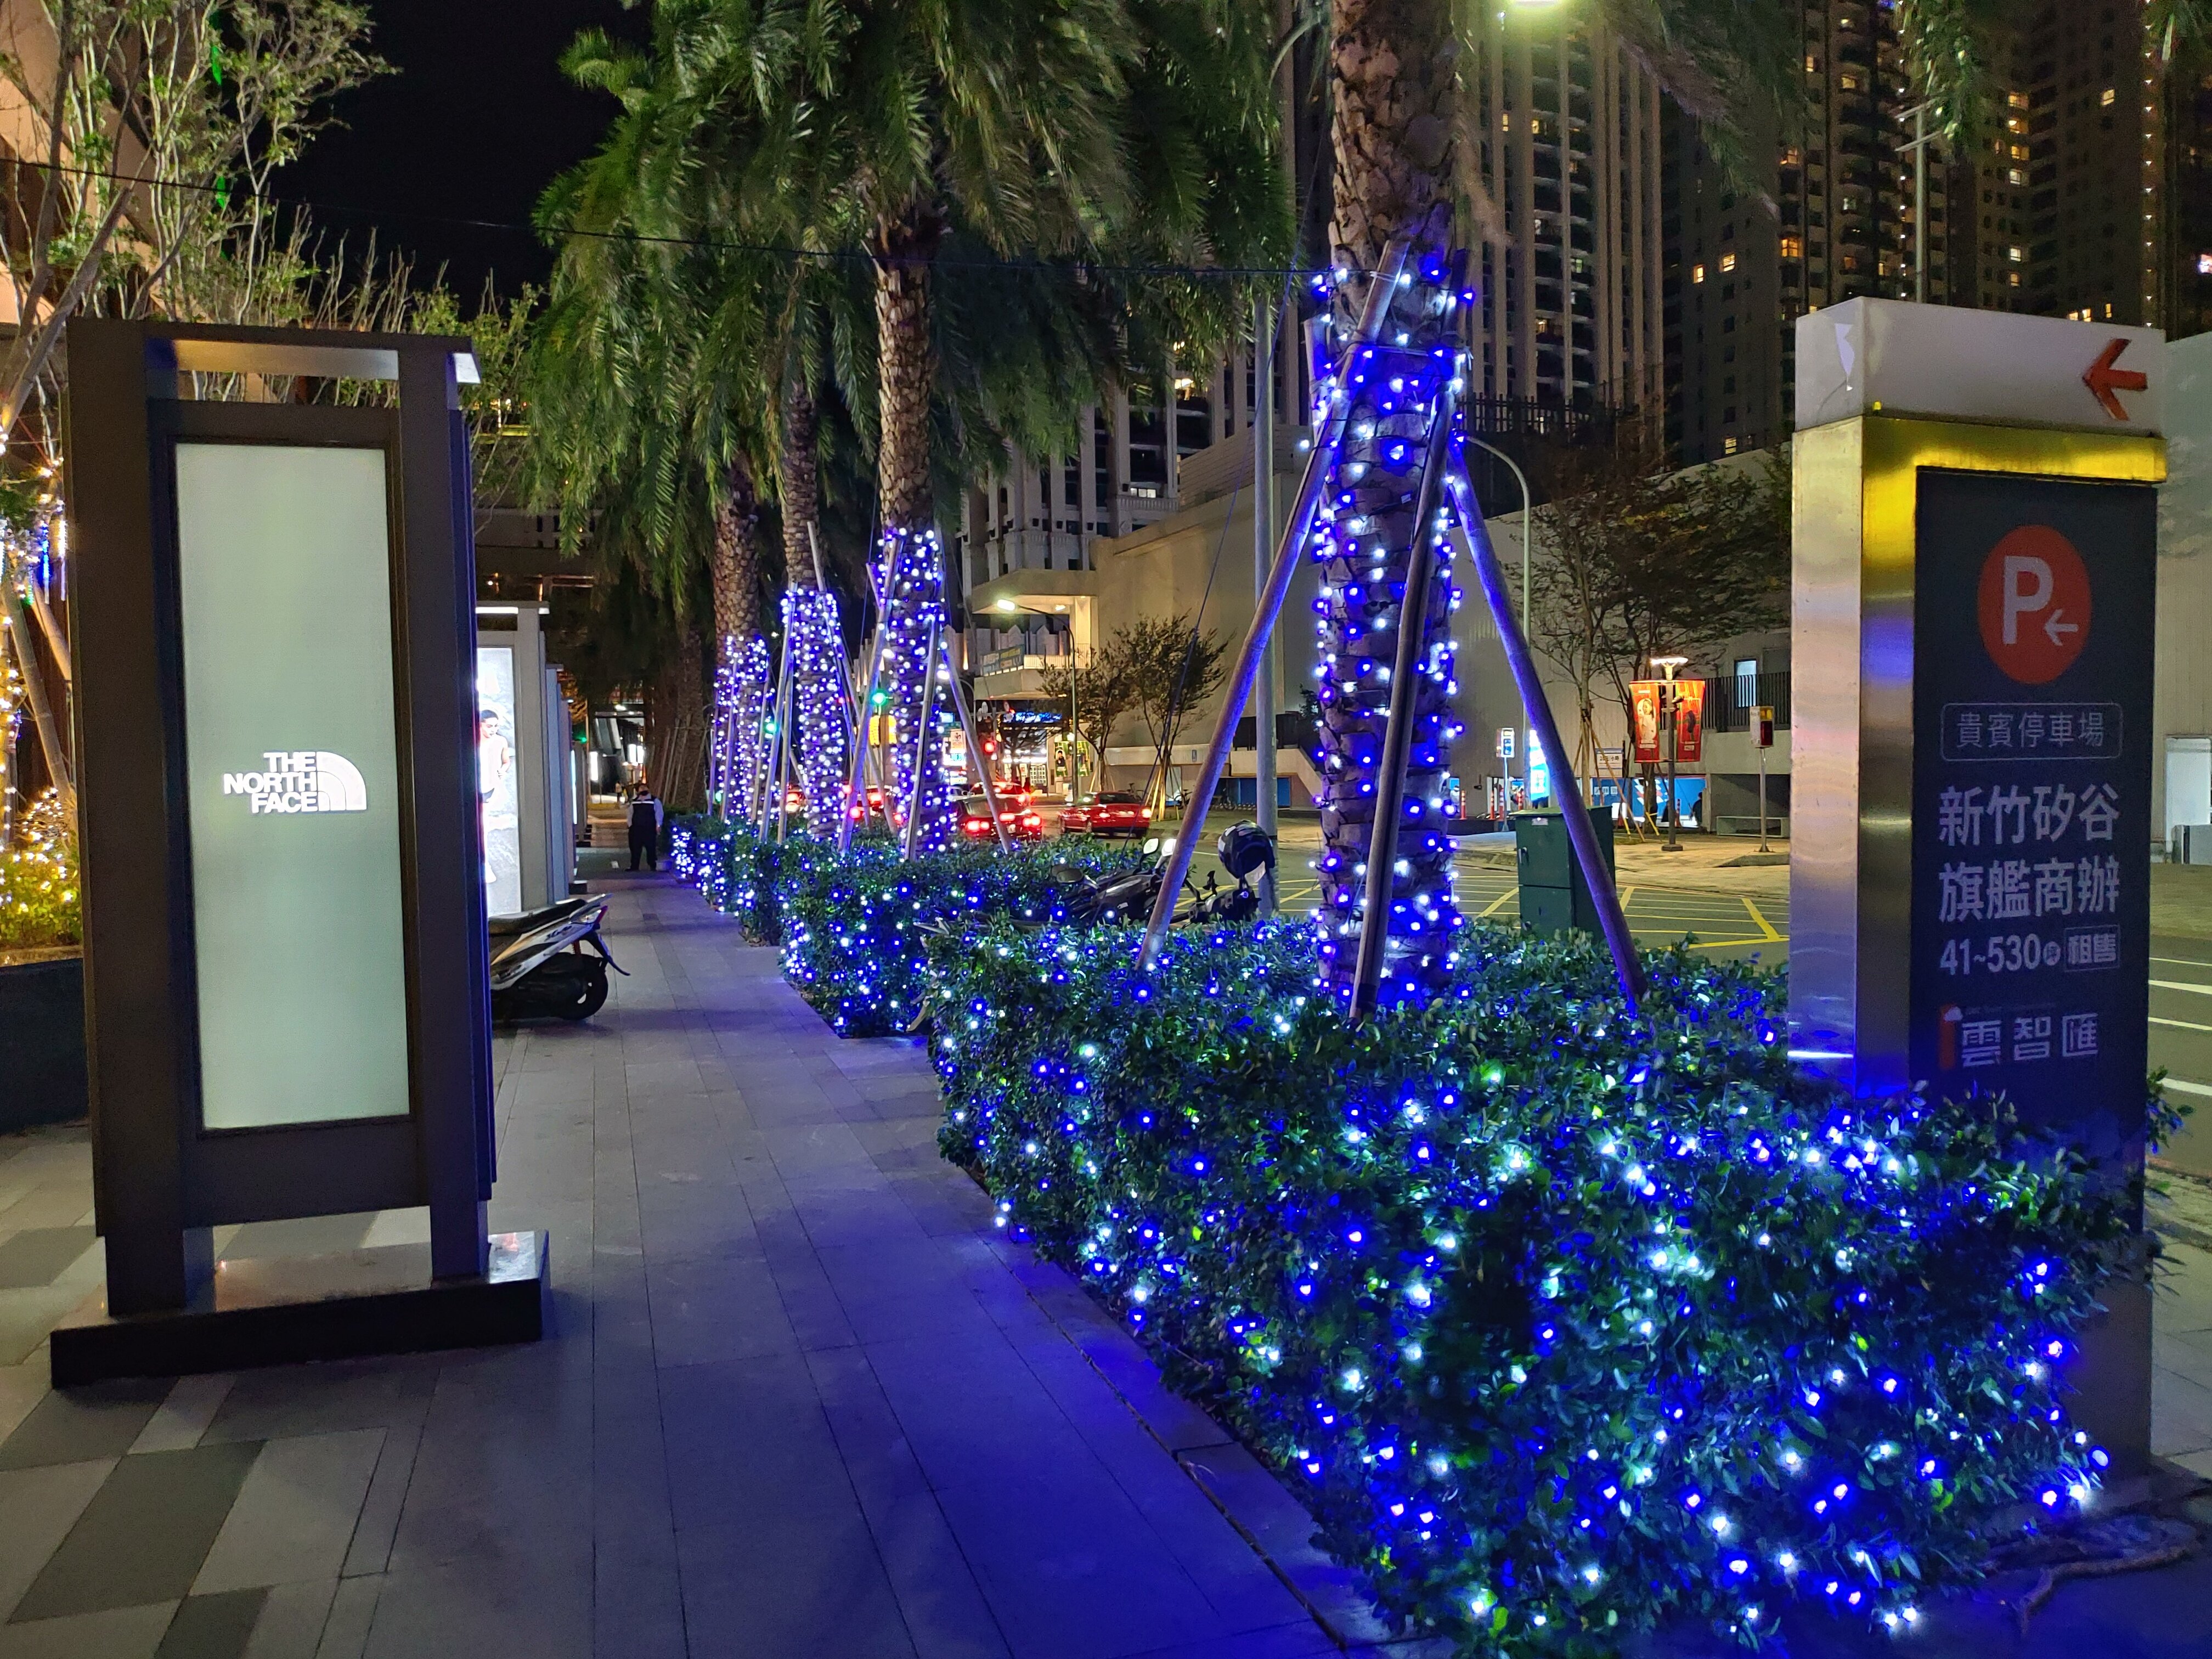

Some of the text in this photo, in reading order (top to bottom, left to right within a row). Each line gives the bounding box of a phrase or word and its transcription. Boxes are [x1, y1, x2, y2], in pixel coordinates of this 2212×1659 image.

[2003, 556, 2053, 645] P
[1956, 712, 2104, 748] 貴賓停車場
[263, 752, 316, 772] THE
[224, 772, 317, 794] NORTH
[252, 792, 318, 813] FACE
[1939, 784, 2119, 847] 新竹矽谷
[1939, 856, 2120, 923] 旗艦商辦
[2067, 935, 2117, 964] 租售
[1961, 1013, 2099, 1068] 雲智匯
